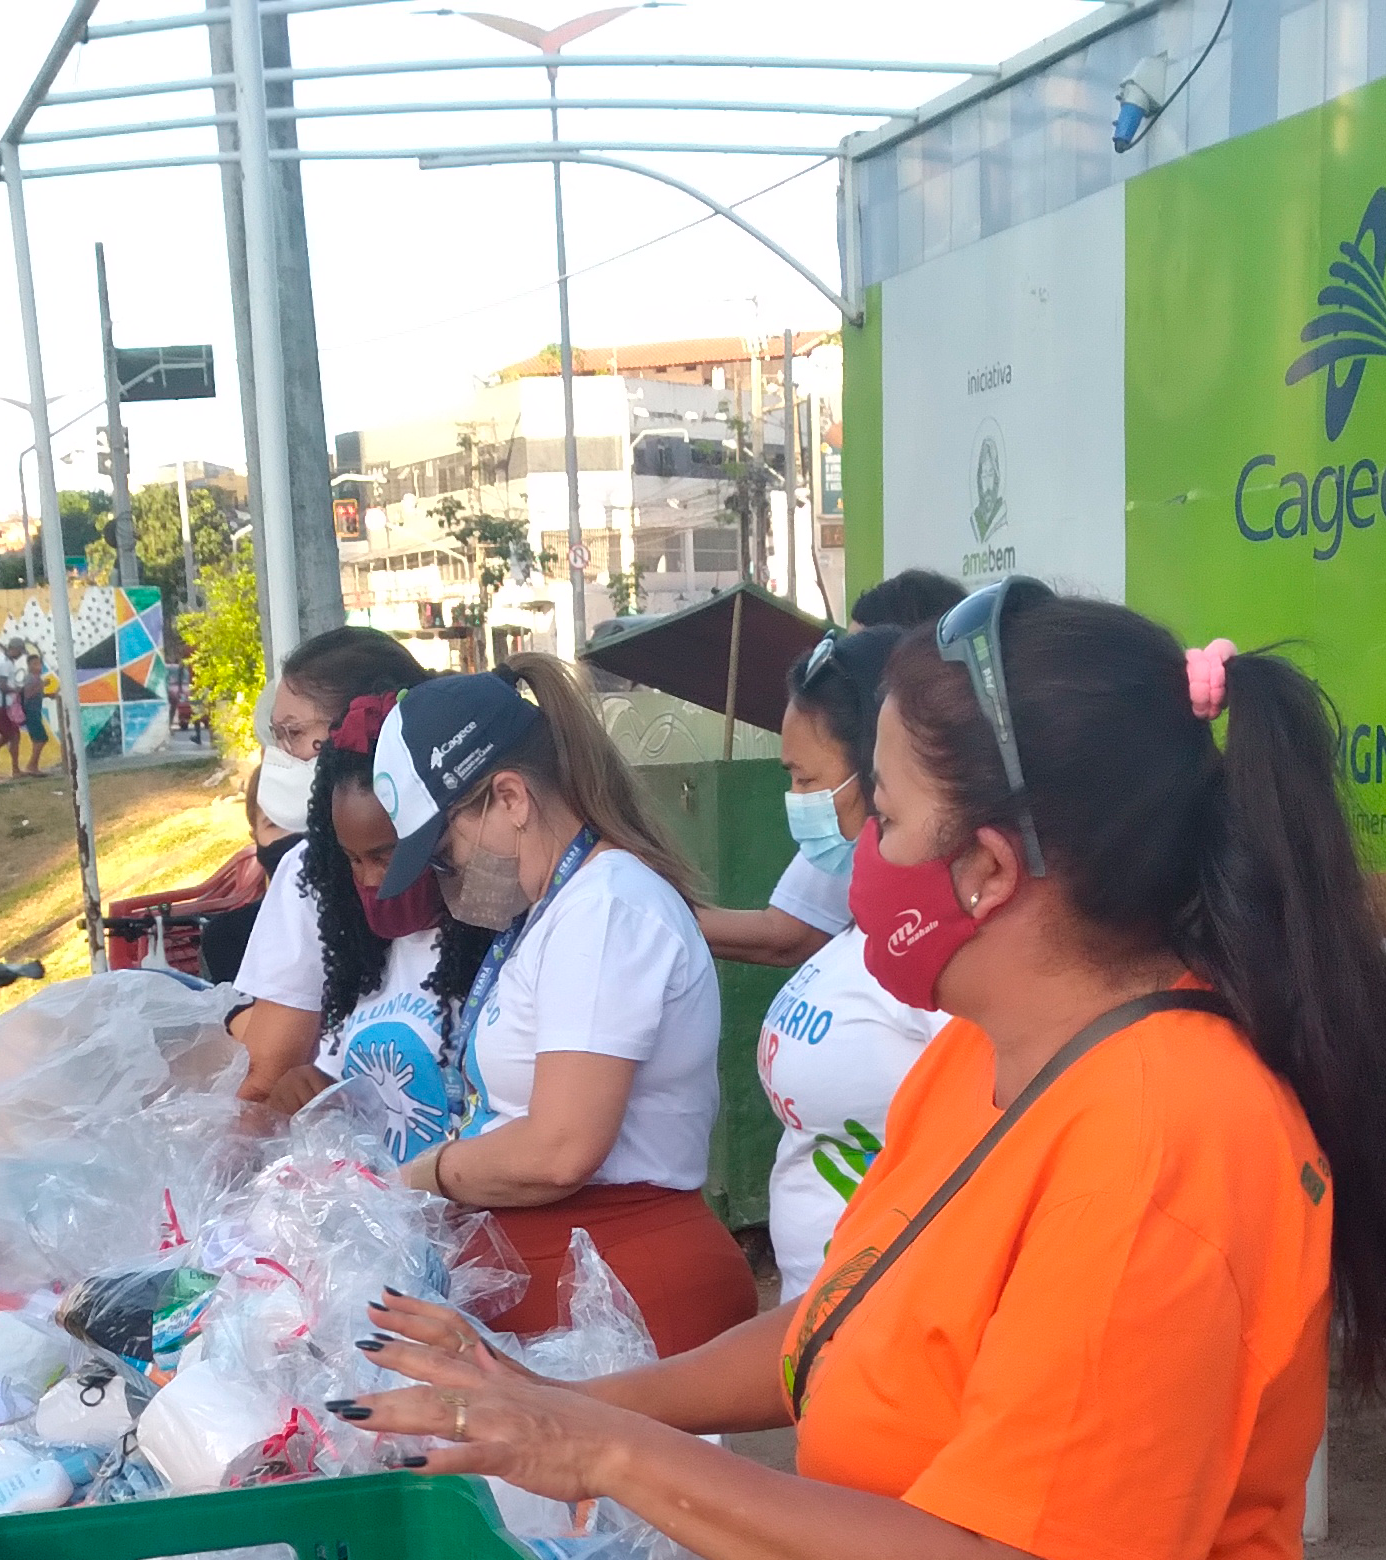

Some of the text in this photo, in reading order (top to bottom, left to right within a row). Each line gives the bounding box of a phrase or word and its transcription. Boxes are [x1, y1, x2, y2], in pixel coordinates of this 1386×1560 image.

[967, 361, 1013, 396] iniciativa
[962, 545, 1016, 577] amebem
[441, 721, 477, 754] Cagece
